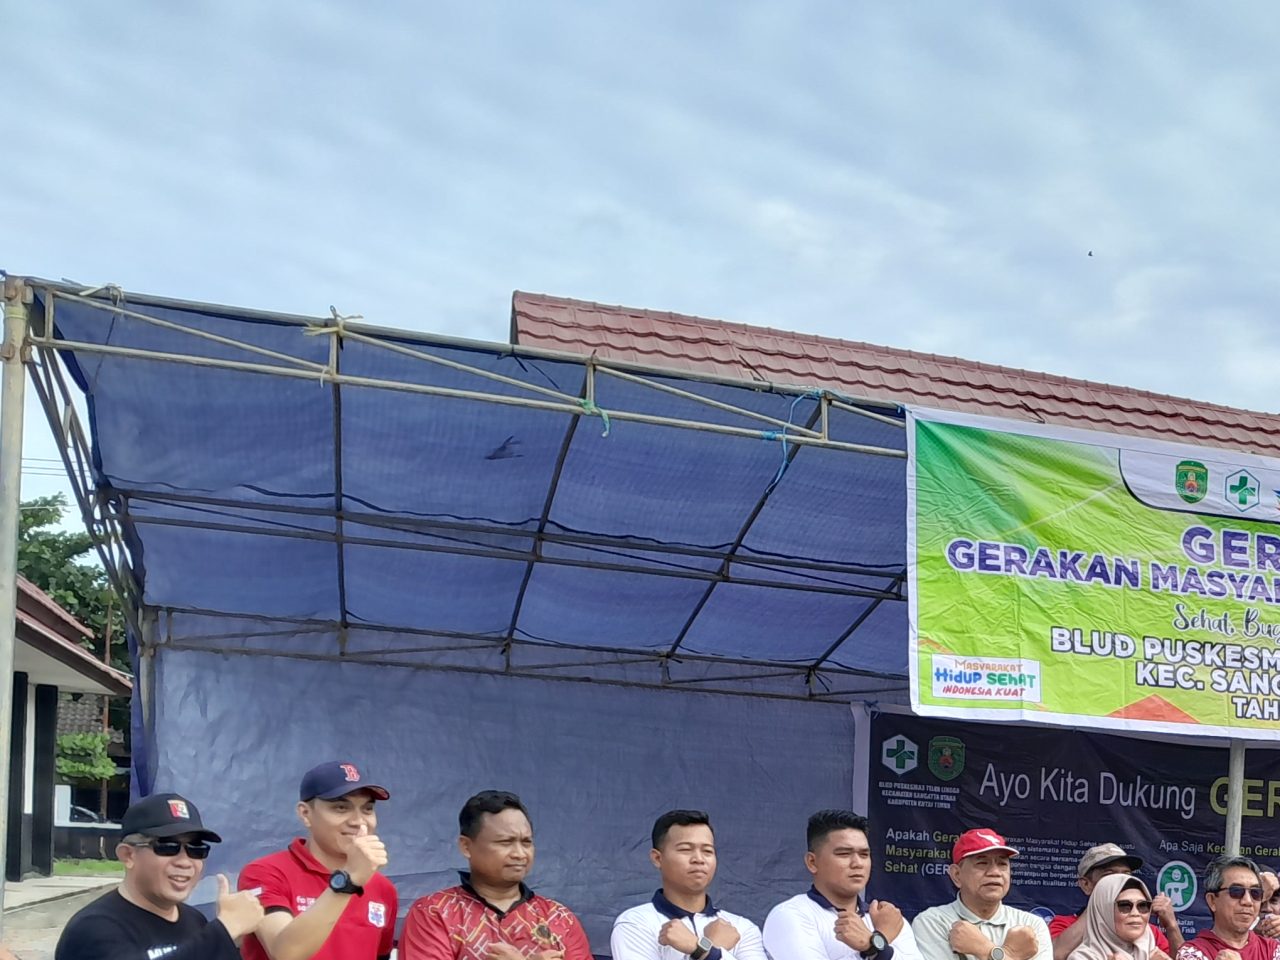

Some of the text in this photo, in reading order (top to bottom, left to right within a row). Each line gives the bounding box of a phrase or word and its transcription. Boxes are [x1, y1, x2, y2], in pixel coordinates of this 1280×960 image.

[947, 540, 1140, 588] GERAKAN
[1051, 627, 1136, 658] BLUD
[1136, 662, 1204, 690] KEC.
[995, 687, 1026, 697] KUAT
[979, 763, 1031, 806] Ayo
[1040, 767, 1089, 803] Kita
[1100, 772, 1196, 819] Dukung
[886, 827, 961, 843] Apakah Gera
[885, 844, 951, 859] Masyarakat
[1159, 839, 1178, 852] Apa
[1181, 840, 1204, 854] Saja
[885, 860, 950, 876] Sehat (GER
